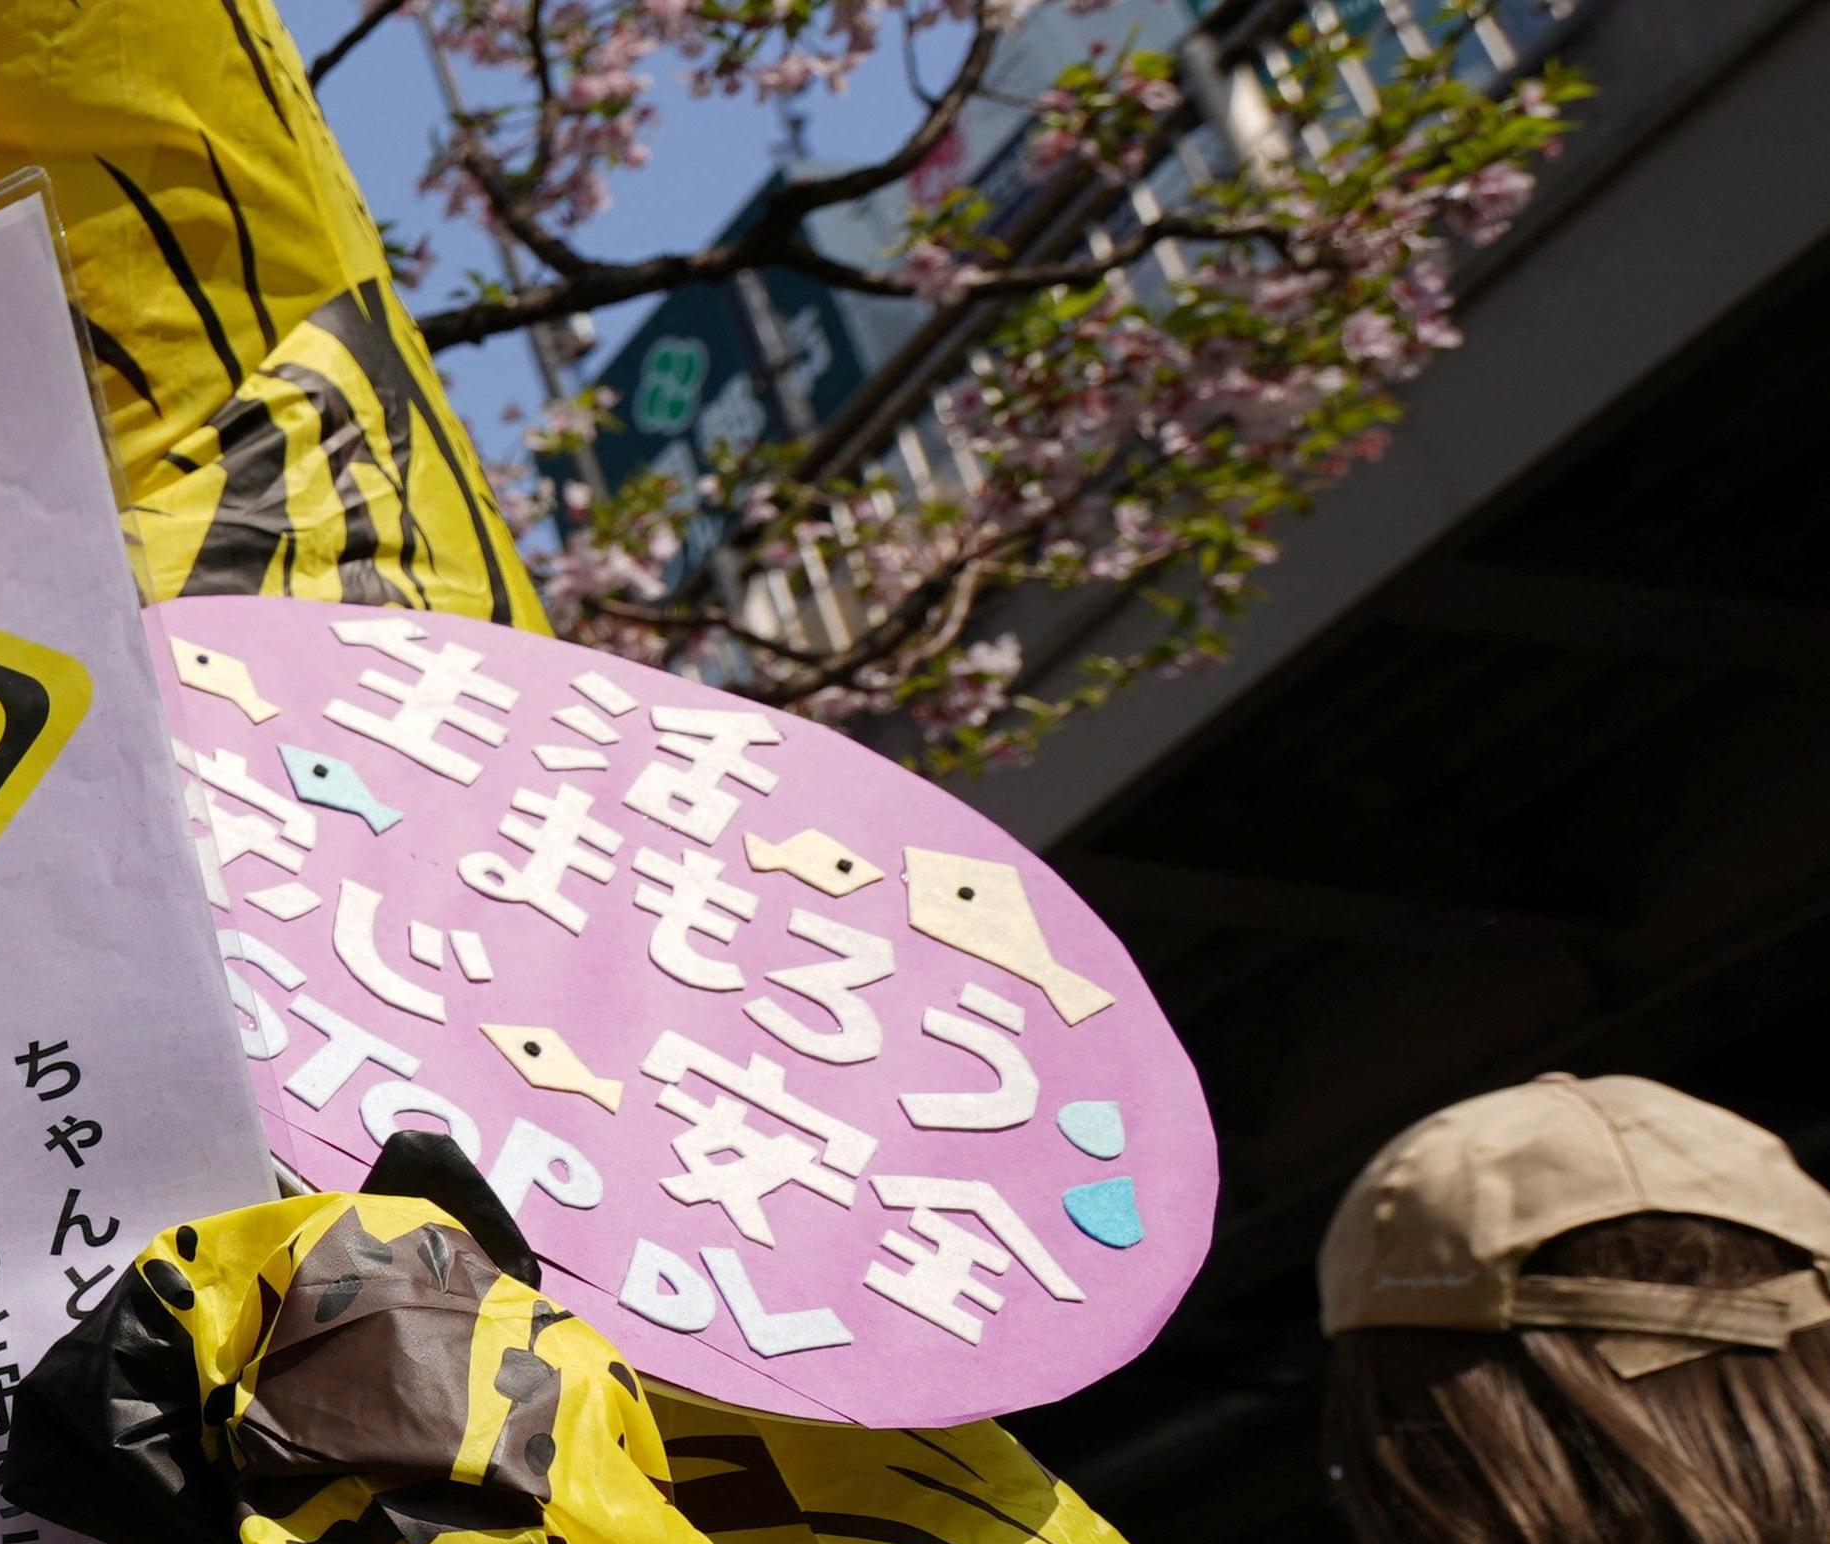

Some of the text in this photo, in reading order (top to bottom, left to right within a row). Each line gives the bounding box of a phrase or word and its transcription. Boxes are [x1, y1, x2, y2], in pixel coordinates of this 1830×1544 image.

[323, 616, 784, 845] 生活
[213, 928, 605, 1218] STOP
[457, 784, 1039, 1131] まもろう
[638, 1029, 1086, 1346] 安全
